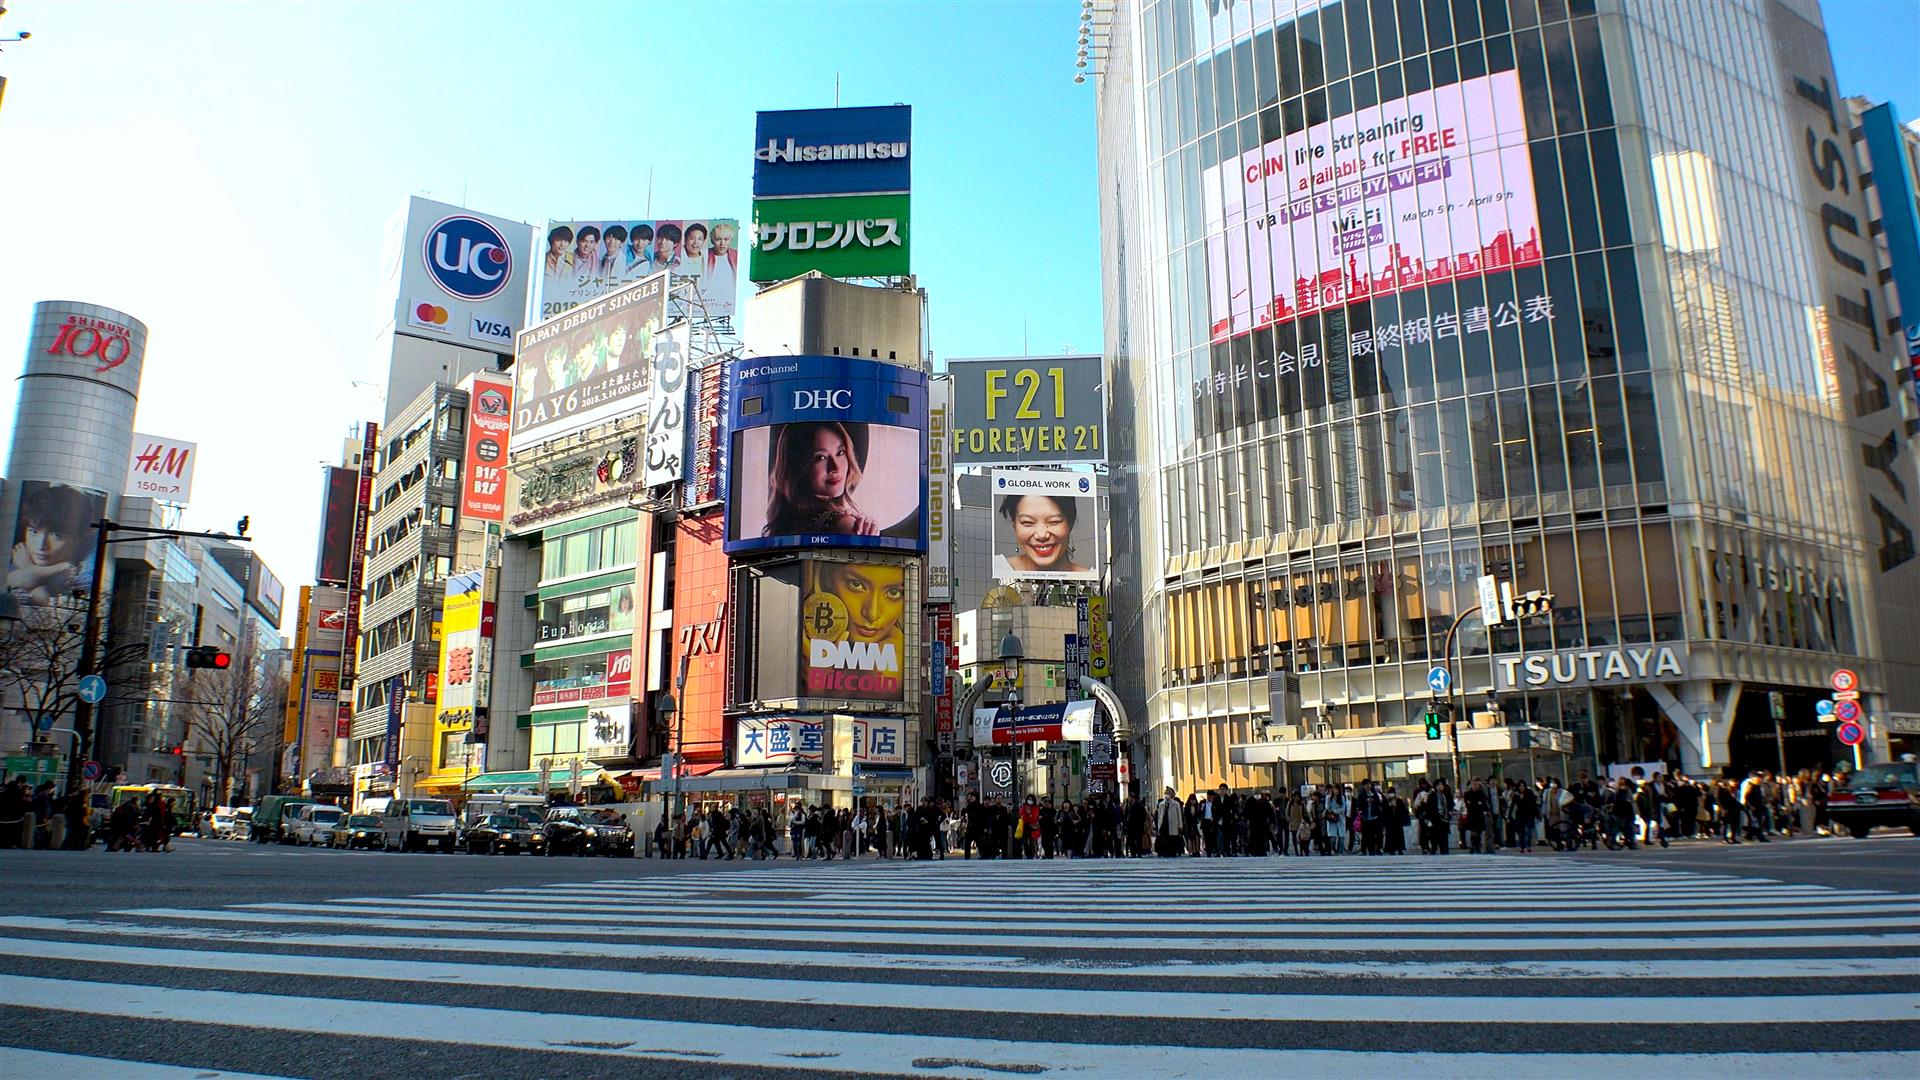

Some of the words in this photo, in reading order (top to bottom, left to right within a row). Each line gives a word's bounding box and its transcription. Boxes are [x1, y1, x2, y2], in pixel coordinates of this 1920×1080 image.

[755, 138, 908, 163] Hisamitsu
[1246, 154, 1285, 185] CNN
[1295, 142, 1325, 167] live
[1333, 112, 1424, 155] streaming
[1299, 158, 1367, 191] available
[1372, 148, 1396, 168] for
[1401, 128, 1457, 160] FREE
[758, 218, 902, 251] サロンパス
[1256, 212, 1278, 232] va
[1332, 208, 1382, 235] Wi-Fi
[67, 315, 132, 338] SHIBUYA
[474, 318, 512, 339] VISA
[524, 324, 560, 349] JAPAN
[563, 302, 606, 331] DEBUT
[608, 281, 660, 312] SINGLE
[1795, 76, 1916, 574] TSUTAYA
[47, 323, 131, 373] 109
[618, 383, 632, 395] ON
[632, 378, 649, 391] SAL
[739, 367, 760, 381] DHC
[760, 363, 799, 377] Channel
[647, 331, 686, 477] もんじゃ
[793, 389, 852, 411] DHC
[985, 367, 1066, 420] F21
[516, 389, 579, 431] DAY6
[929, 402, 946, 475] Taisei
[954, 426, 1067, 454] FOREVER
[1074, 424, 1100, 451] 21
[135, 443, 189, 479] H&M
[137, 480, 169, 495] 150m
[1008, 479, 1044, 489] GLOBAL
[1044, 480, 1071, 489] WORK
[930, 480, 944, 541] neon
[811, 536, 829, 544] DHC
[541, 616, 606, 640] Euphoria
[680, 602, 727, 657] クスリ
[810, 639, 898, 672] DMM
[1093, 659, 1105, 668] 4F
[1498, 645, 1684, 687] TSUTAYA
[808, 671, 898, 693] Bitcoin
